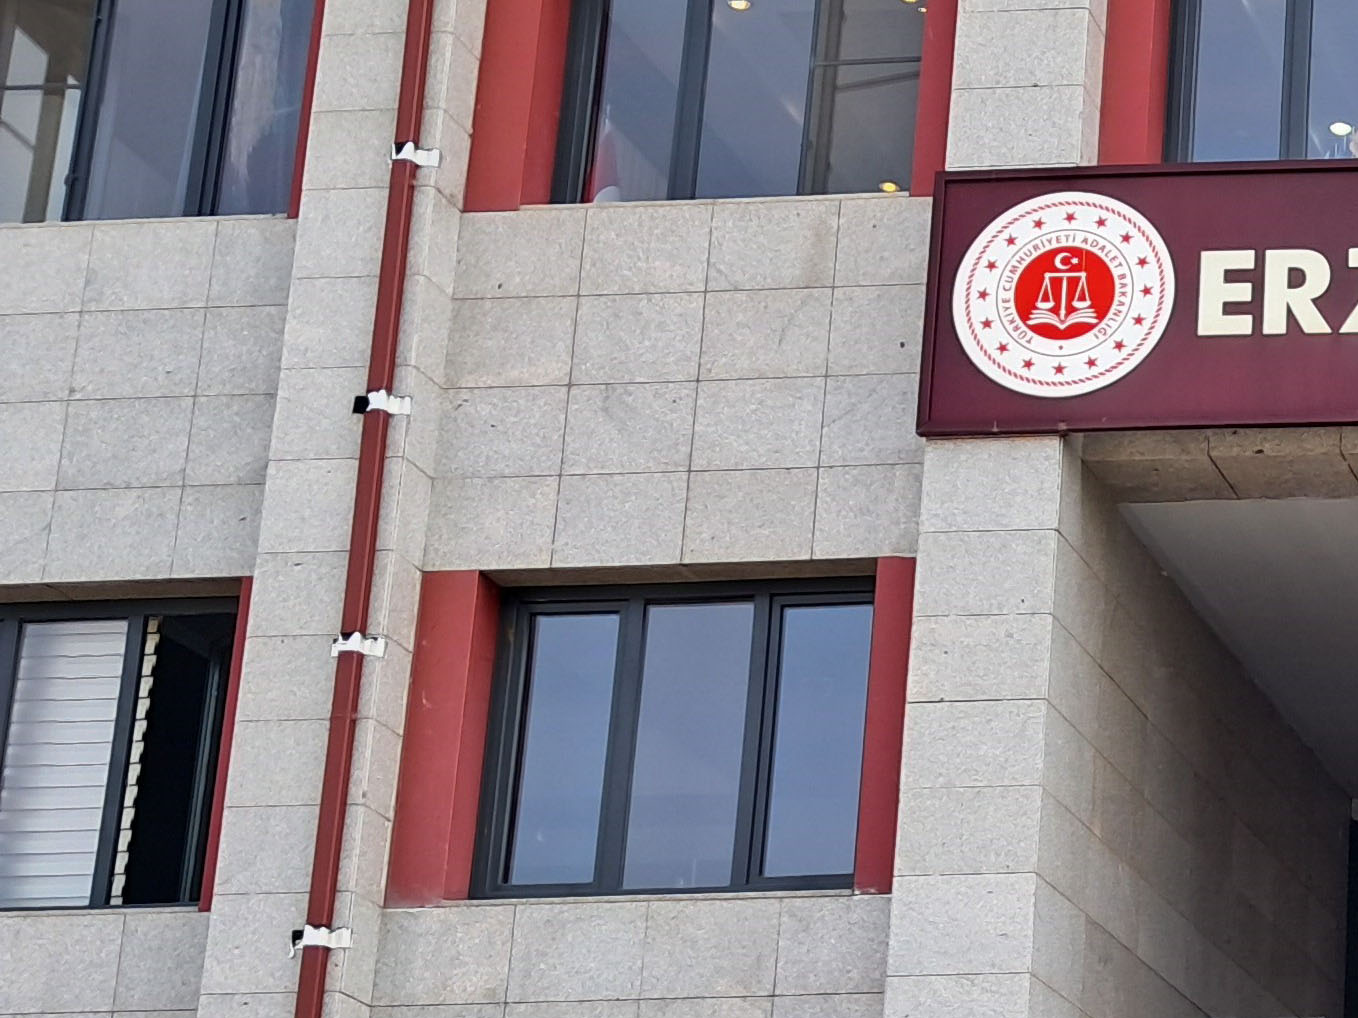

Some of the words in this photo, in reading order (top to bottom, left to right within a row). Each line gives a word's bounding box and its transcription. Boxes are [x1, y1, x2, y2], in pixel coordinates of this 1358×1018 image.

[1004, 234, 1076, 292] CUMHURİYETİ
[1081, 238, 1123, 268] ADALET
[1002, 298, 1033, 344] TÜRKİYE
[1094, 274, 1128, 340] BAKANLIĞI
